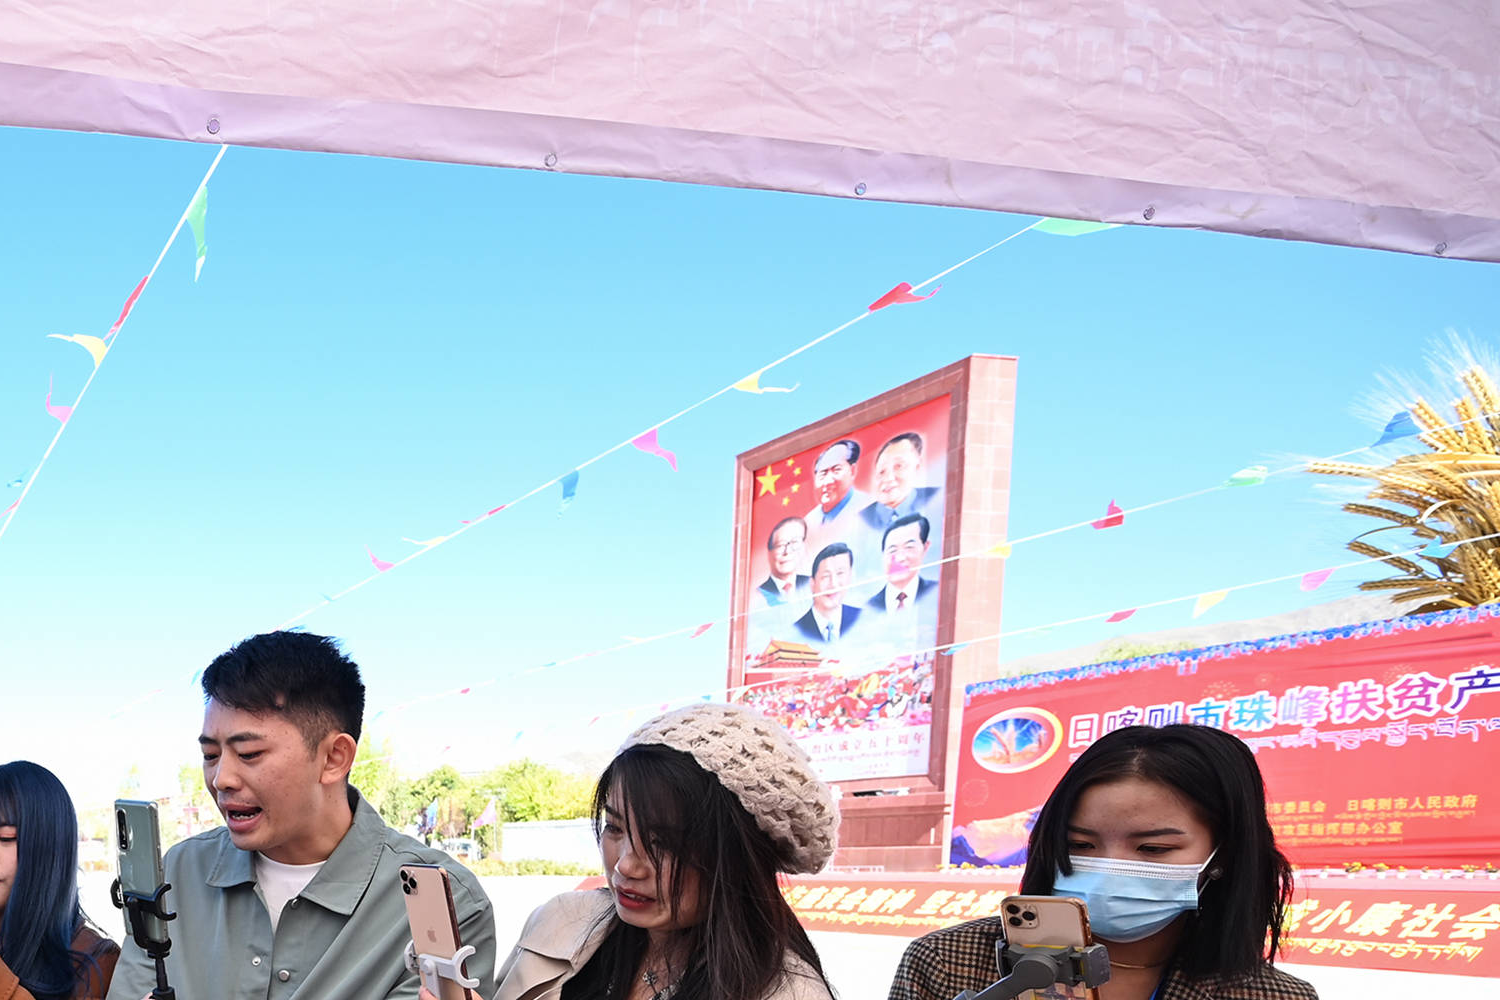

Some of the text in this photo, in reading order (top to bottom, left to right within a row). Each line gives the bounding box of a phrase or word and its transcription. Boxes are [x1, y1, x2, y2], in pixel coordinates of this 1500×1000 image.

[1347, 794, 1478, 812] 日喀则市人民政府
